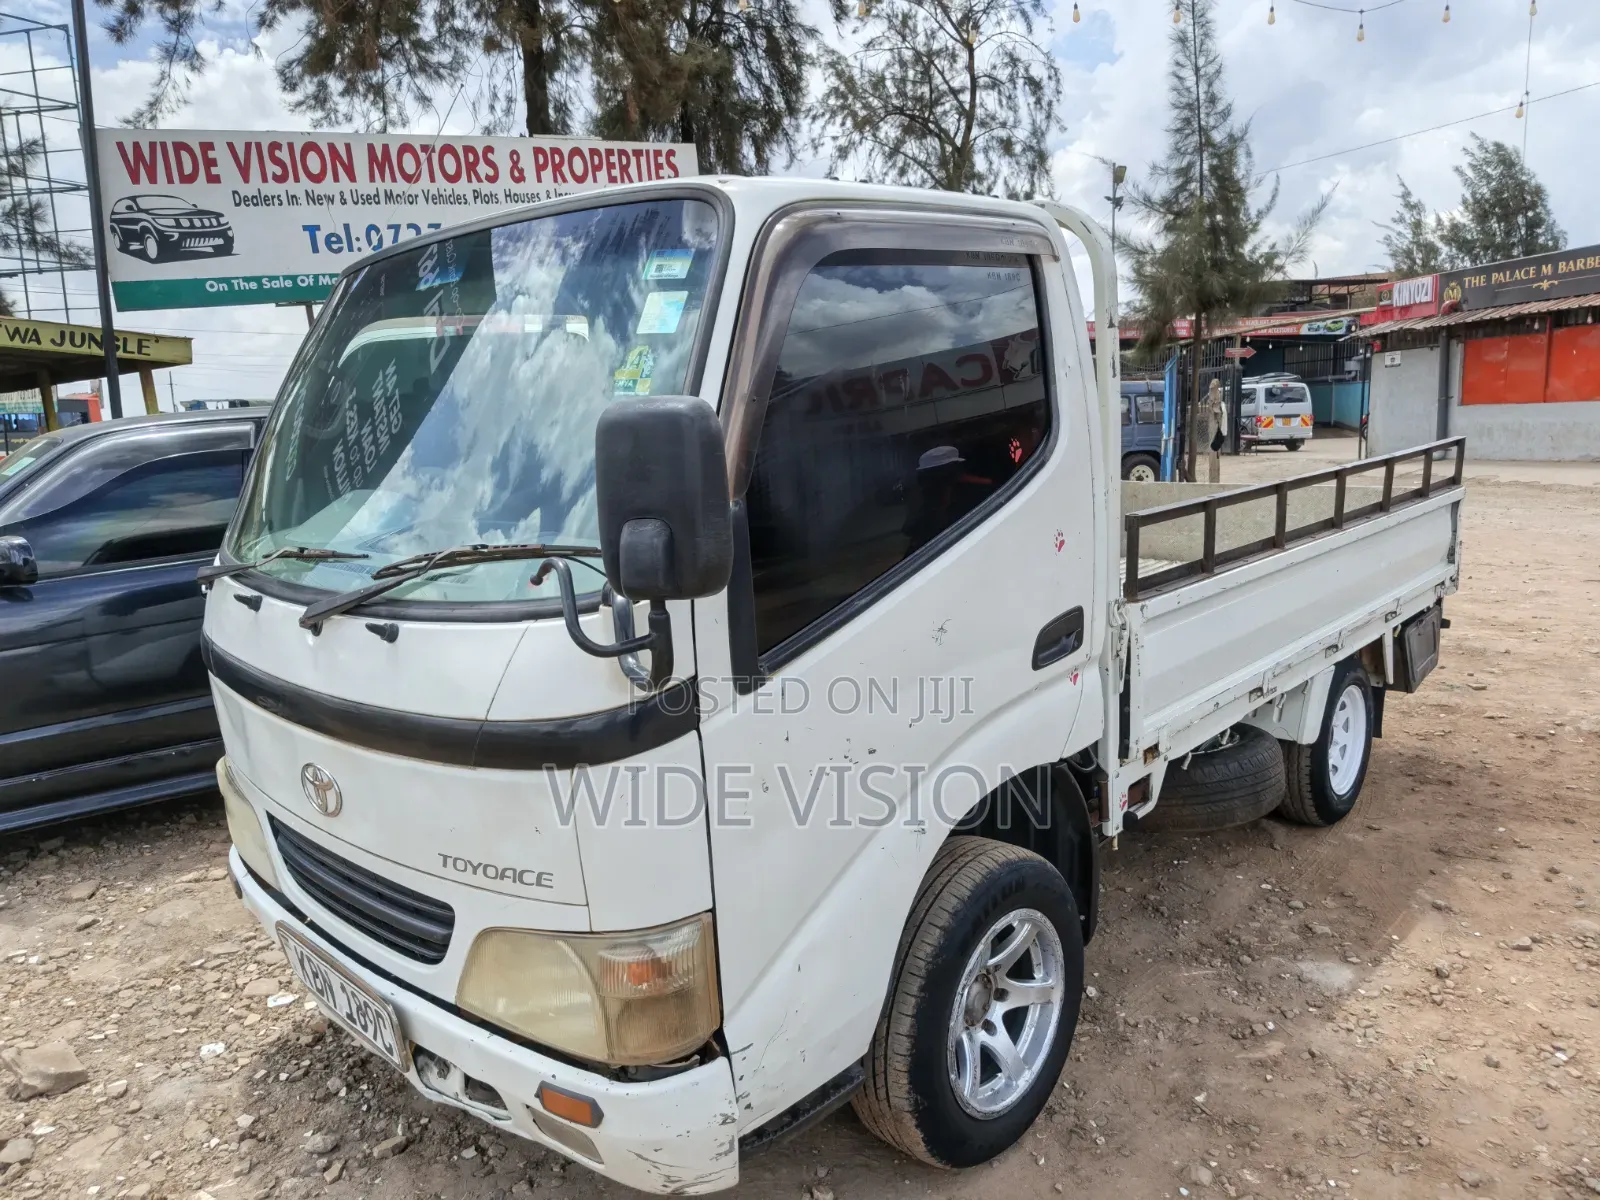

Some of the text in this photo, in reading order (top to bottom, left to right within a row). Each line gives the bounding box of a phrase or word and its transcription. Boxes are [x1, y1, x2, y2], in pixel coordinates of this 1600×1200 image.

[116, 141, 680, 185] WIDE VISION MOTORS & PROPERTIES
[231, 188, 283, 208] Dealers
[305, 189, 335, 206] New
[339, 192, 347, 206] &
[350, 189, 381, 206] Used
[384, 188, 420, 206] Motor
[421, 188, 471, 207] Vehicles,
[205, 281, 229, 292] On
[231, 279, 258, 291] The
[262, 277, 293, 290] Sale
[297, 274, 315, 288] Of
[1393, 276, 1434, 308] KINYOZI
[1463, 274, 1487, 289] THE
[1491, 266, 1536, 285] PALACE
[1540, 264, 1553, 276] M
[437, 852, 554, 889] TOYOACE
[293, 945, 395, 1057] KBN 189C
